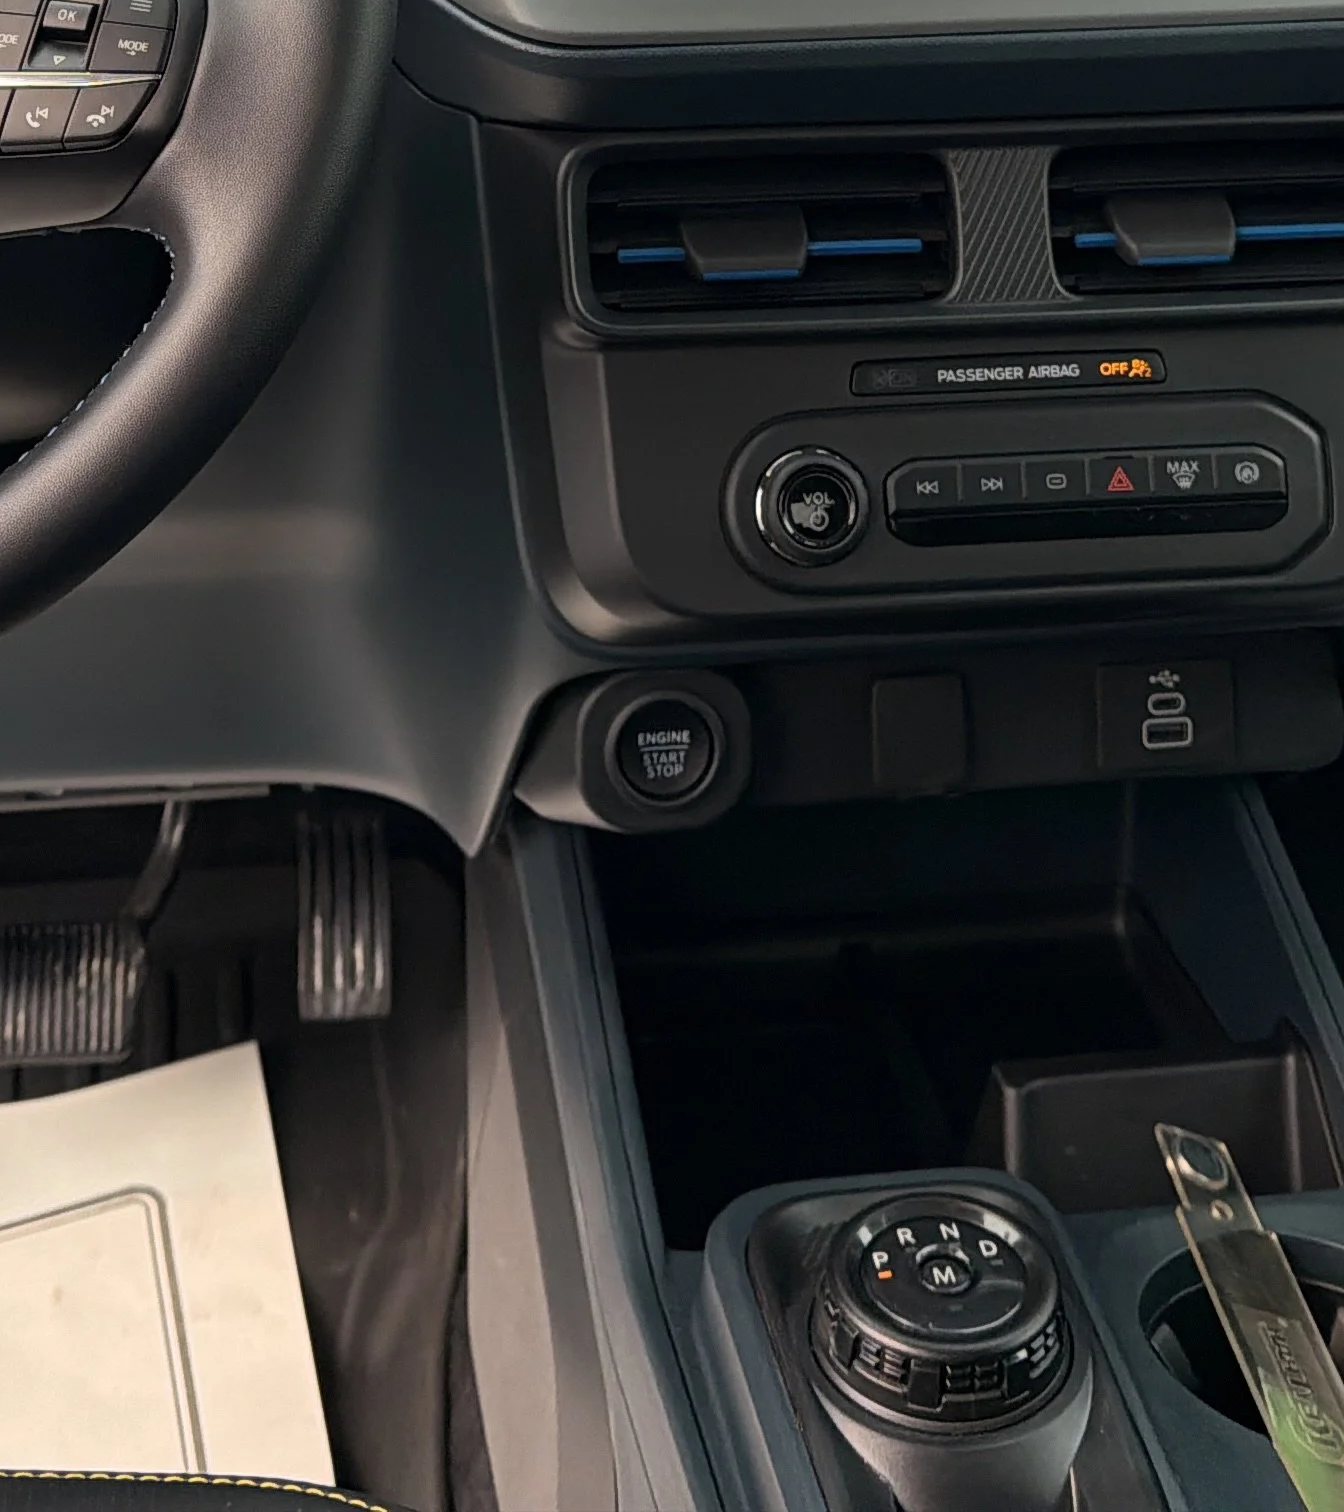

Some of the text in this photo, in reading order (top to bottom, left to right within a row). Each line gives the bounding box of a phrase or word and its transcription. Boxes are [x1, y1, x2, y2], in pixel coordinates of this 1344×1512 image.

[58, 9, 77, 23] OK
[117, 39, 150, 53] MODE
[937, 367, 1024, 383] PASSENGER
[1028, 364, 1080, 379] AIRBAG
[1099, 362, 1128, 376] OFF
[1166, 460, 1200, 474] MAX
[802, 491, 836, 505] VOL
[637, 730, 690, 746] ENGINE
[643, 751, 686, 767] START
[646, 763, 684, 779] STOP
[872, 1222, 998, 1270] P R N D
[932, 1265, 957, 1286] M
